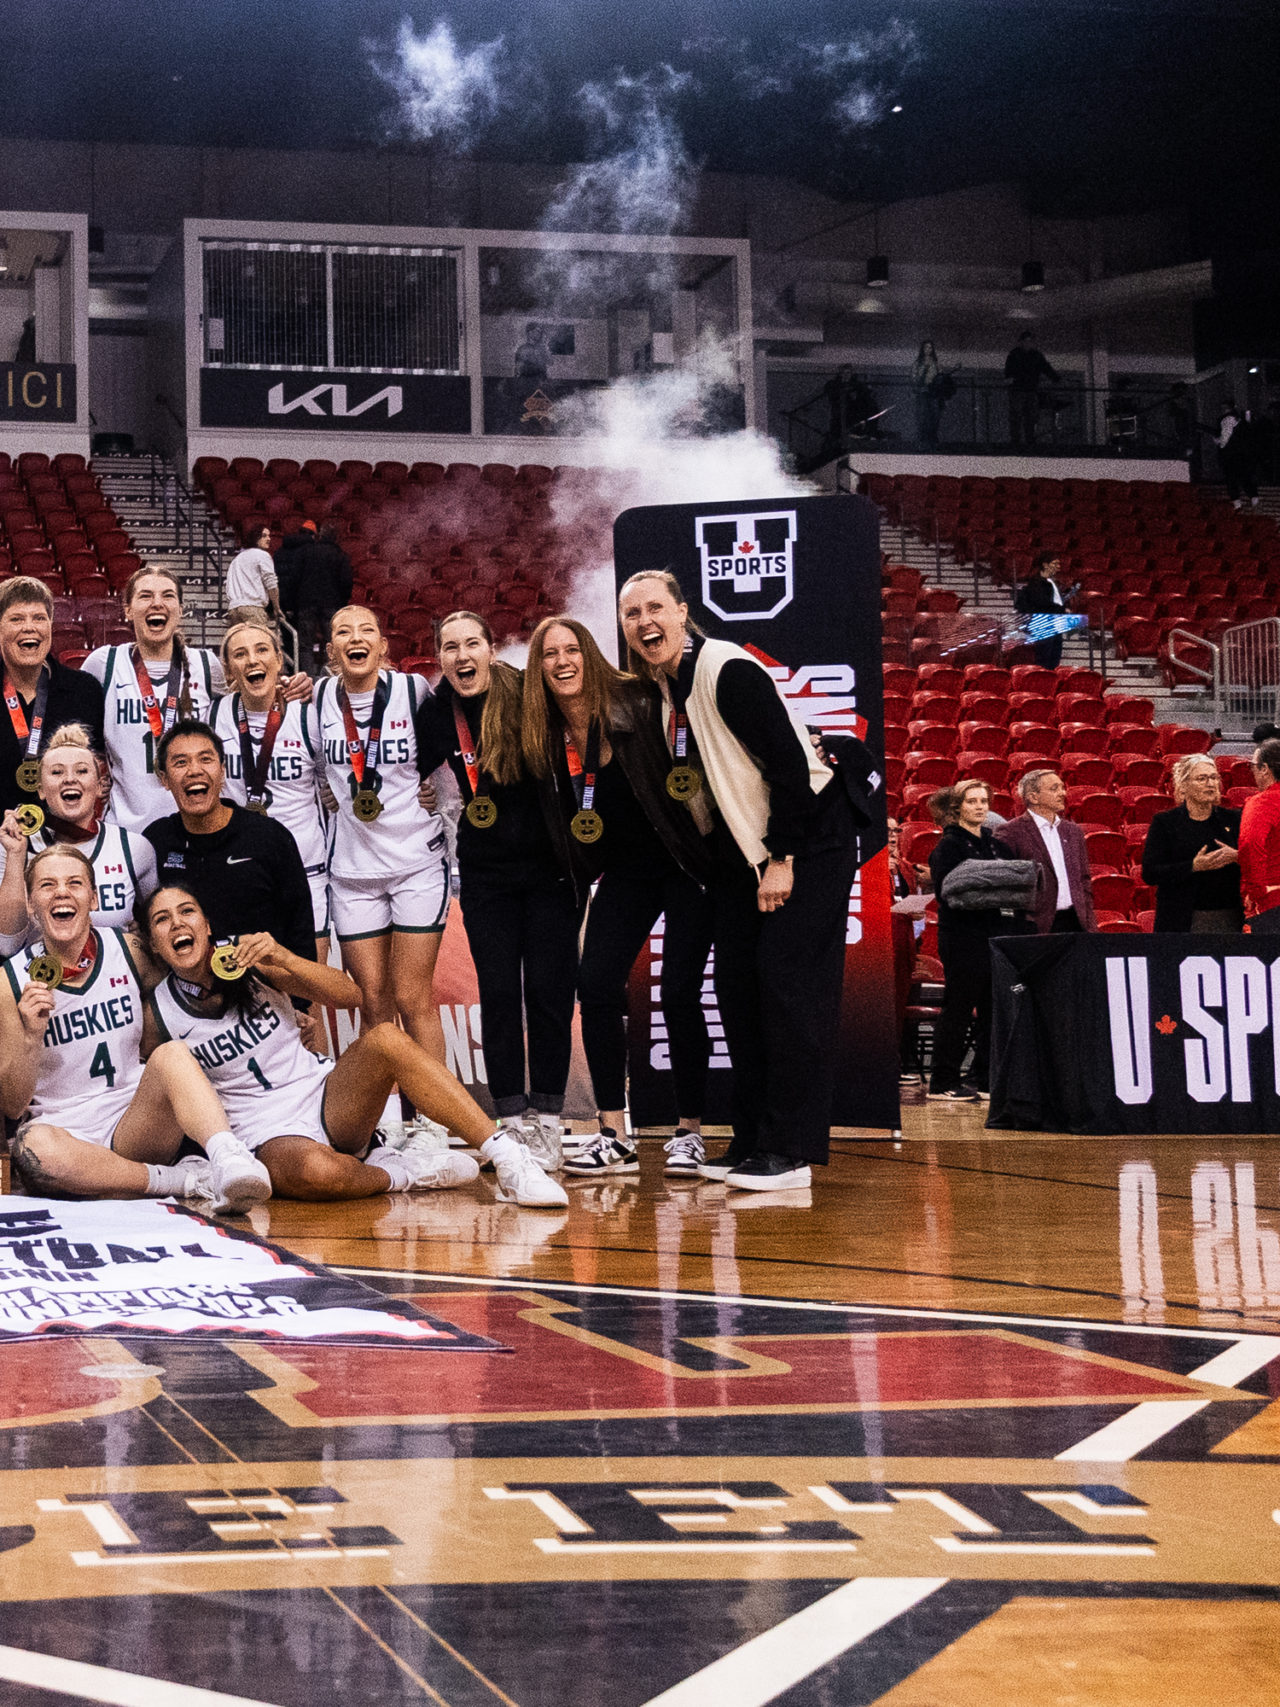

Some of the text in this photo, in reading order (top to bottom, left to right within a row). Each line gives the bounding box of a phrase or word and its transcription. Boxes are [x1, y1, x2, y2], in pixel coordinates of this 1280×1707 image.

[7, 370, 63, 409] ICI
[268, 382, 403, 418] KIA
[707, 555, 786, 577] SPORTS
[224, 753, 302, 781] UIES
[324, 738, 409, 765] HUIES
[43, 994, 135, 1048] HUSKIES
[189, 1000, 281, 1069] HUSKIES
[1105, 955, 1280, 1105] U SP
[89, 1041, 116, 1088] 4
[247, 1057, 272, 1091] 1
